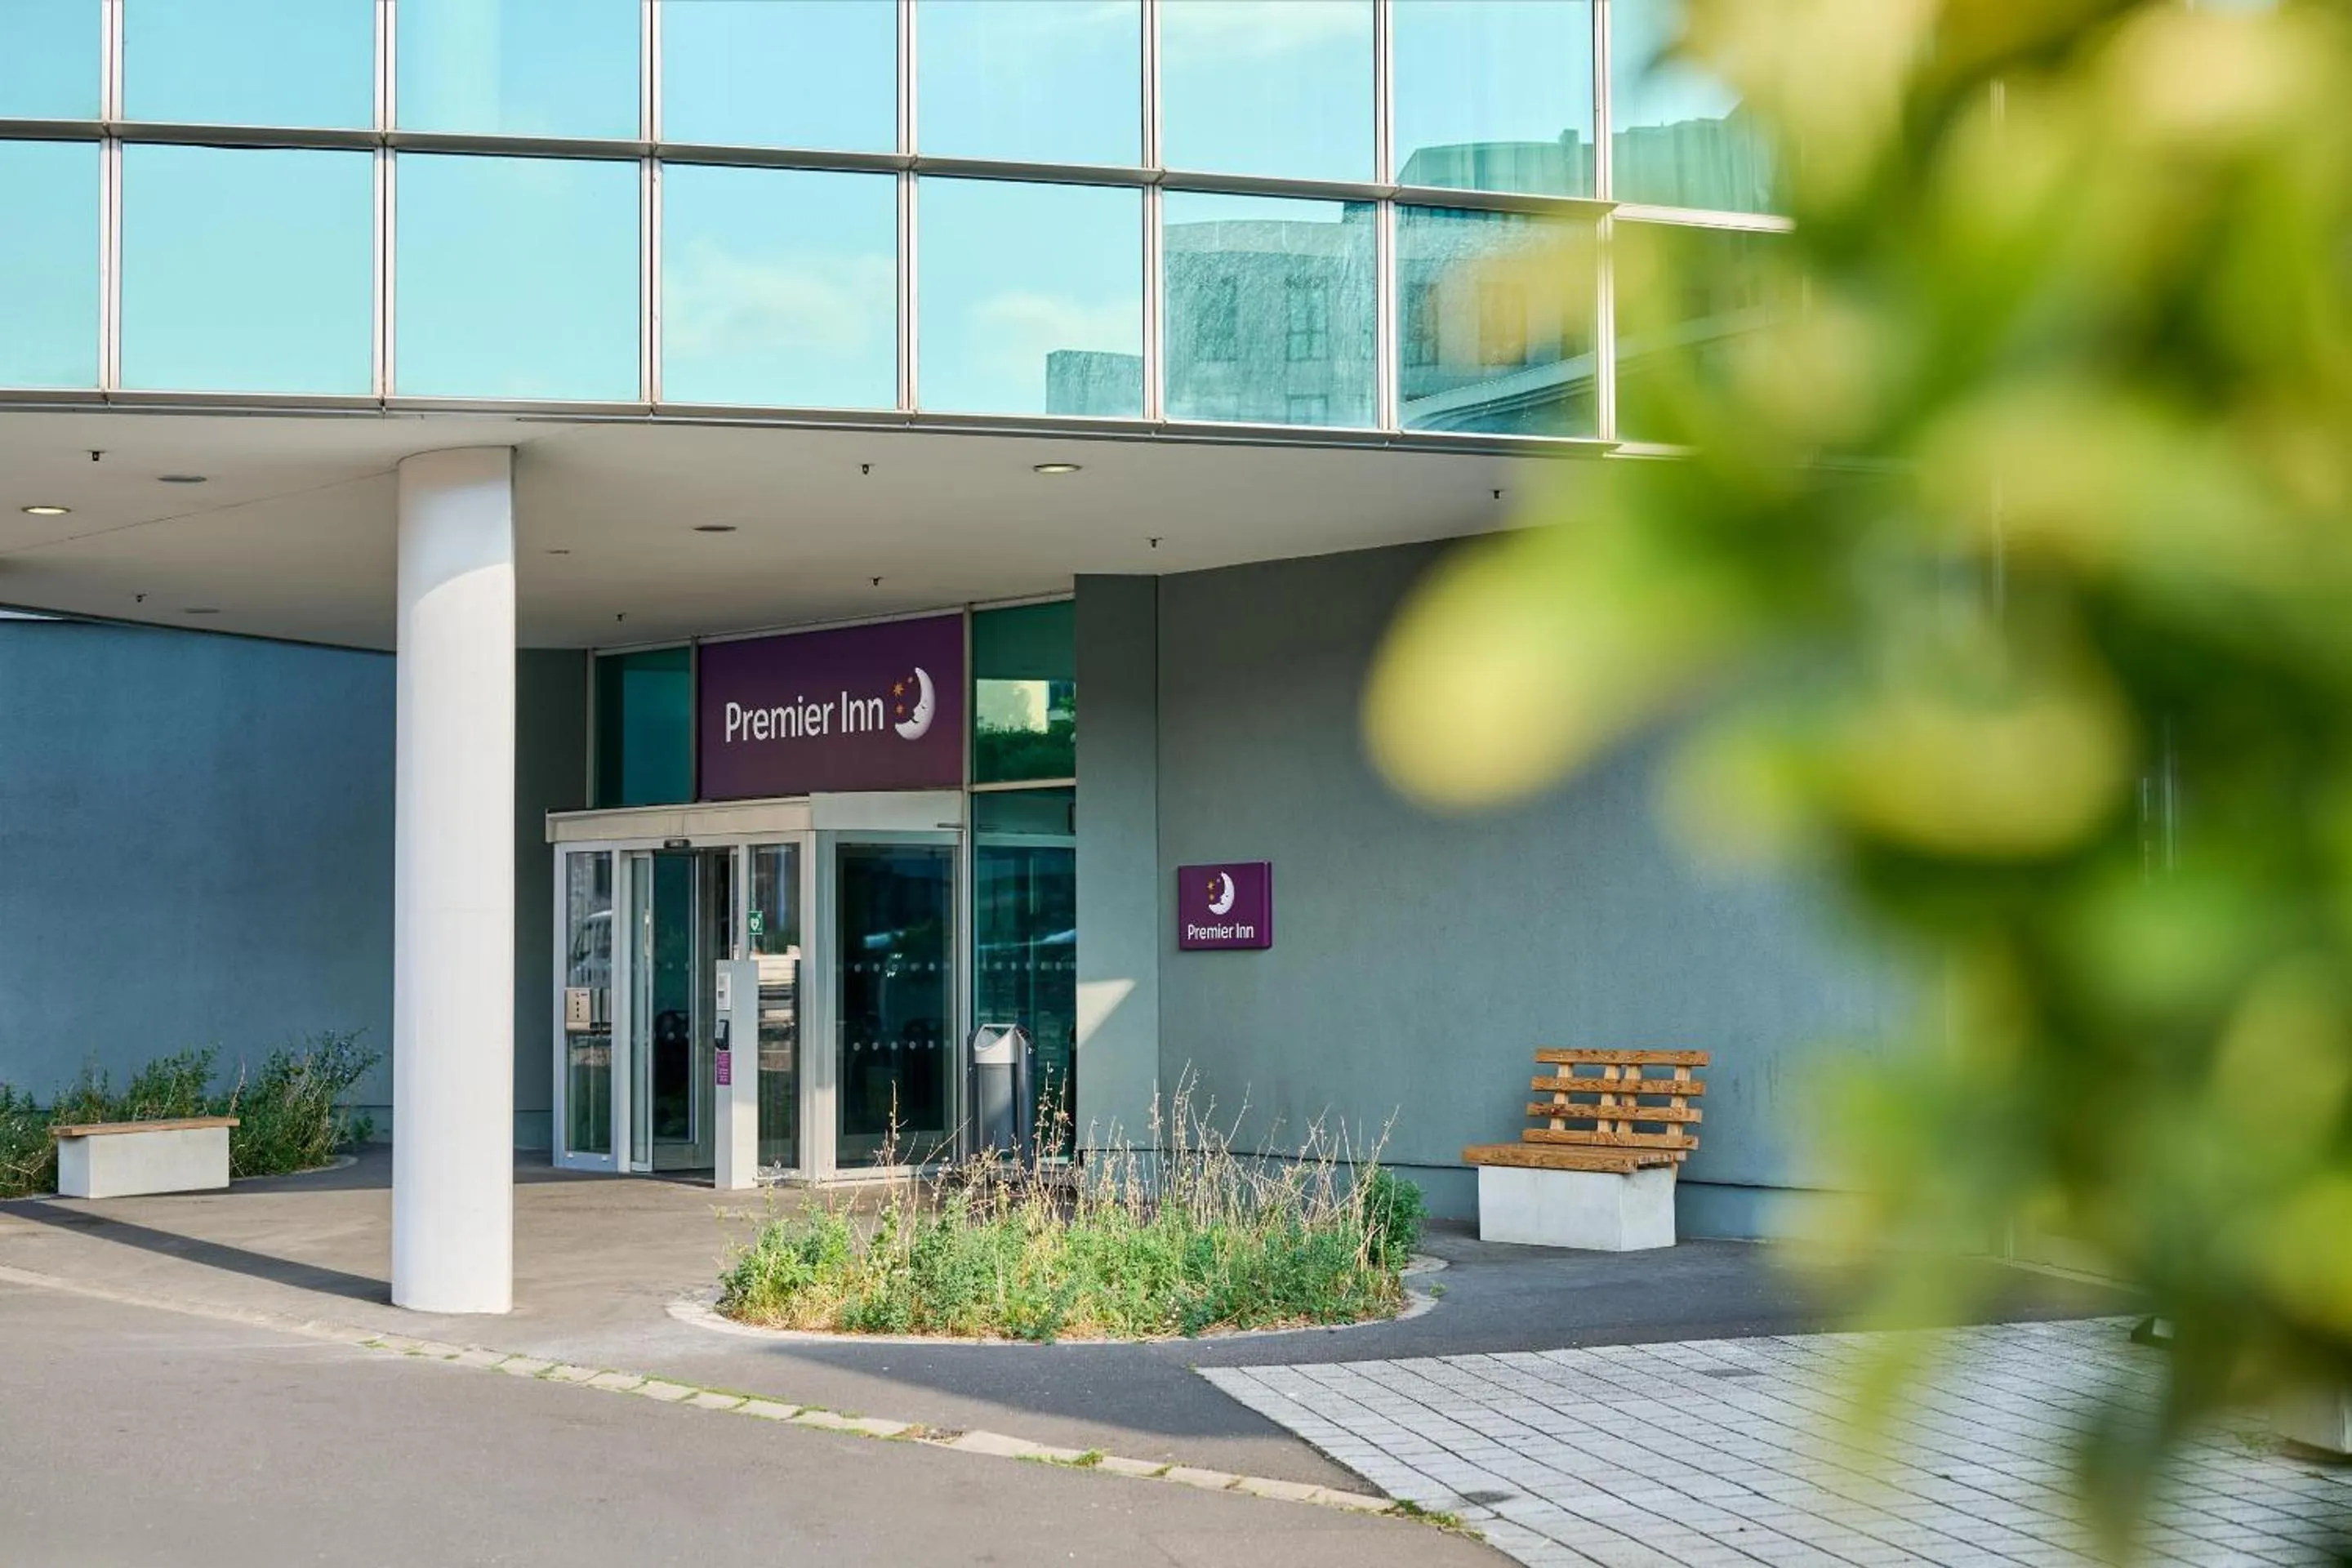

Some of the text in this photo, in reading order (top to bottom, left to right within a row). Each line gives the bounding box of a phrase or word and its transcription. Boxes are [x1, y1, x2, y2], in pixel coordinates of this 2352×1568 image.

[725, 691, 884, 743] Premier Inn
[1187, 923, 1254, 940] Premier Inn
